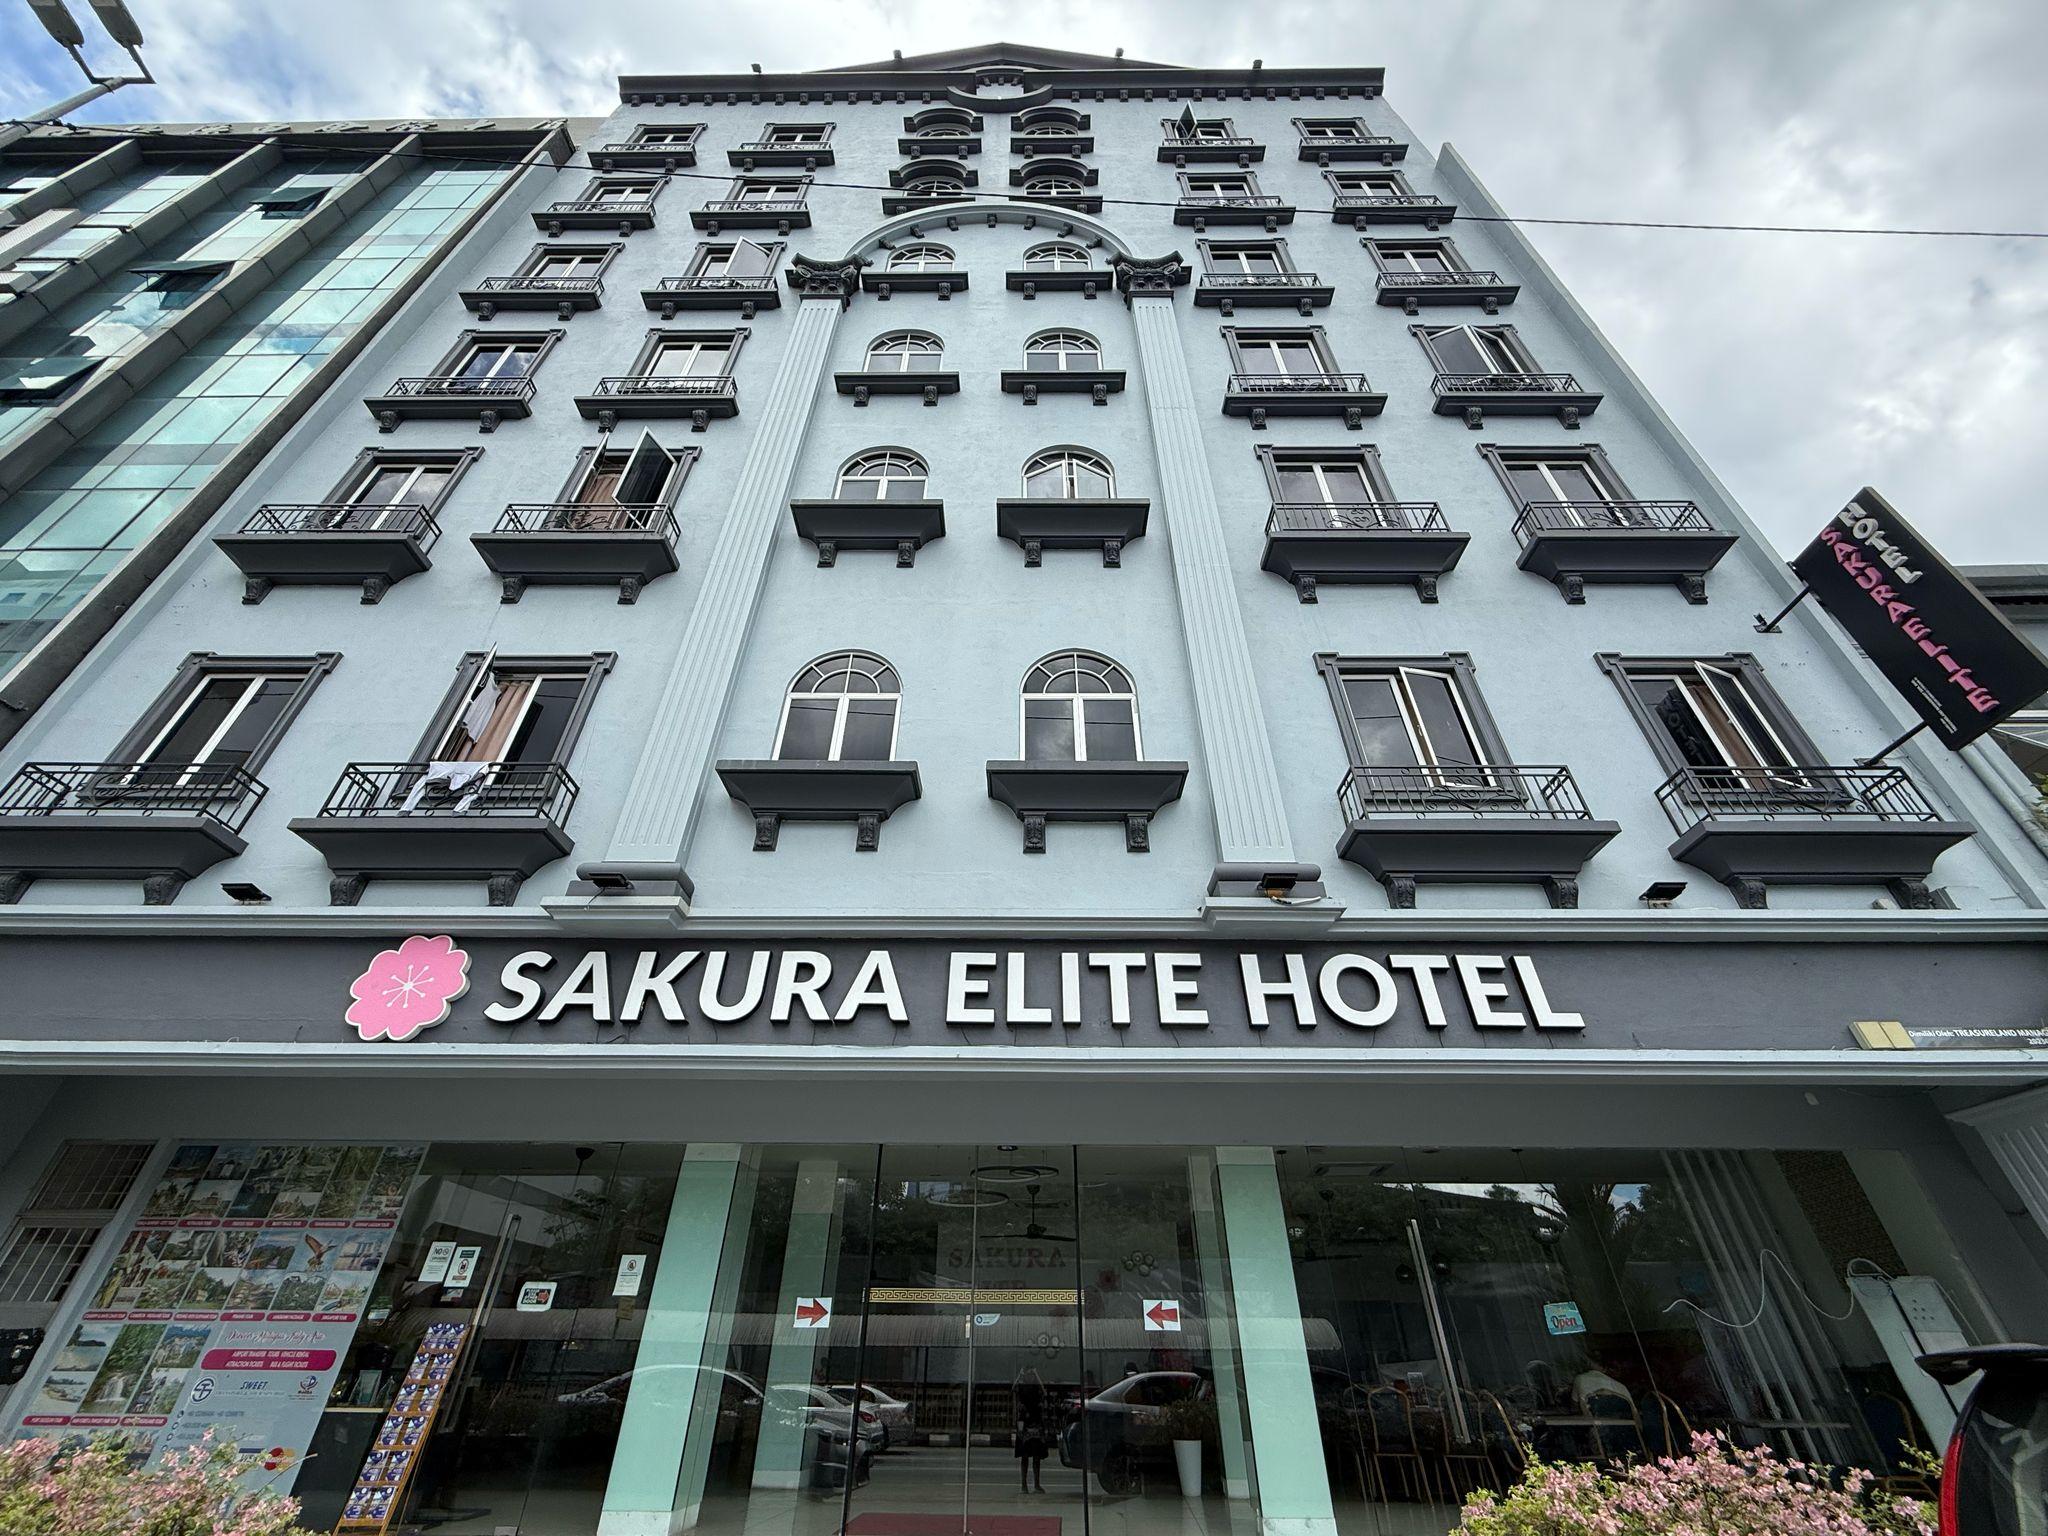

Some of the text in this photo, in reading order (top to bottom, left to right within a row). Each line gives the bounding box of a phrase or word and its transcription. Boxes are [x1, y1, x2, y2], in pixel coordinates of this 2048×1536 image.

[1838, 502, 1923, 584] HOTEL
[1821, 527, 1915, 623] SAKURA
[1902, 617, 2000, 713] ELITE
[483, 950, 1587, 1031] SAKURA ELITE HOTEL
[1953, 1029, 2017, 1037] TREASURELAND
[948, 1247, 1066, 1269] SAKURA
[1551, 1315, 1577, 1331] Open
[240, 1381, 269, 1390] SWEET
